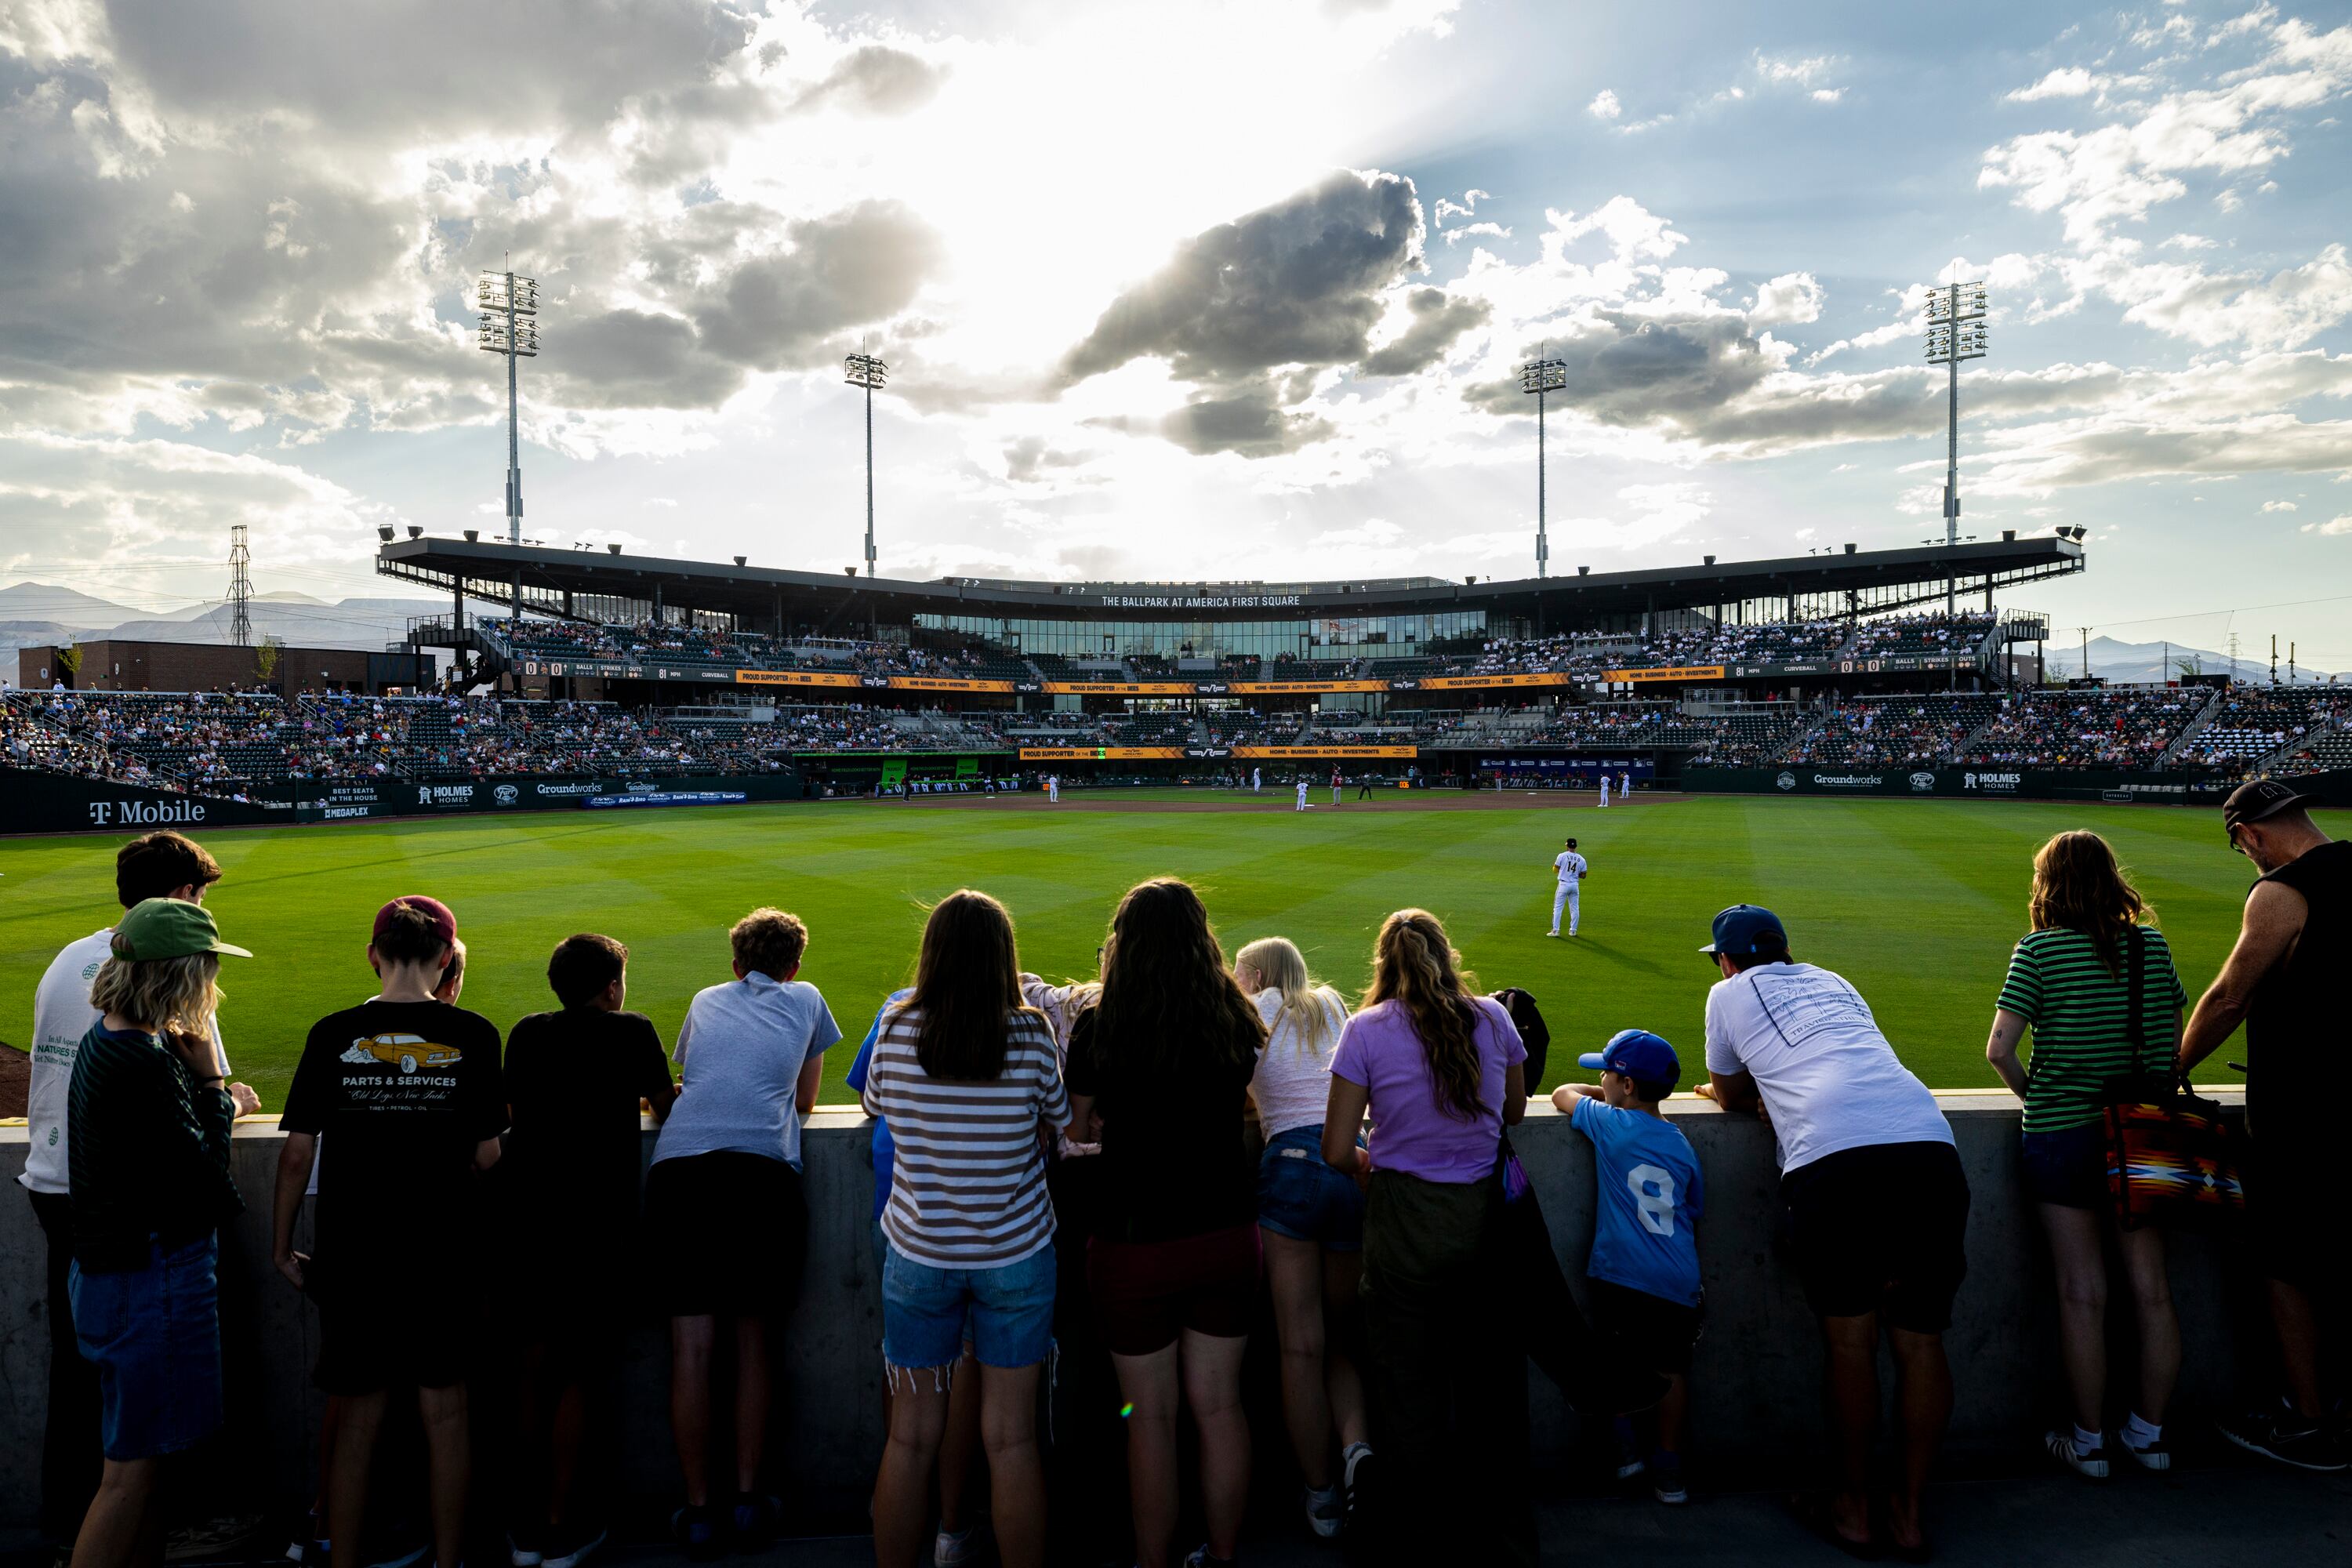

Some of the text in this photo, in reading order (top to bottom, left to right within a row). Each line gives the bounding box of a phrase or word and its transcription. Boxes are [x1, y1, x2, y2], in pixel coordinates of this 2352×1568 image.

[1102, 596, 1300, 607] THE BALLPARK AT AMERICA FIRST SQUARE
[528, 663, 534, 674] 0
[554, 664, 560, 674] 0
[1844, 662, 1849, 672] 0
[1871, 661, 1877, 670] 0
[659, 669, 666, 679] 81
[1736, 667, 1744, 677] 81
[1814, 774, 1882, 784] Groundworks
[1979, 773, 2020, 783] HOLMES
[434, 786, 474, 797] HOLMES
[537, 782, 602, 794] Groundworks
[89, 800, 205, 824] T Mobile
[331, 807, 368, 818] MEGAPLEX
[1567, 861, 1577, 873] 14
[38, 1044, 70, 1057] NATURES
[343, 1076, 456, 1087] PARTS & SERVICES
[1628, 1163, 1675, 1237] 8
